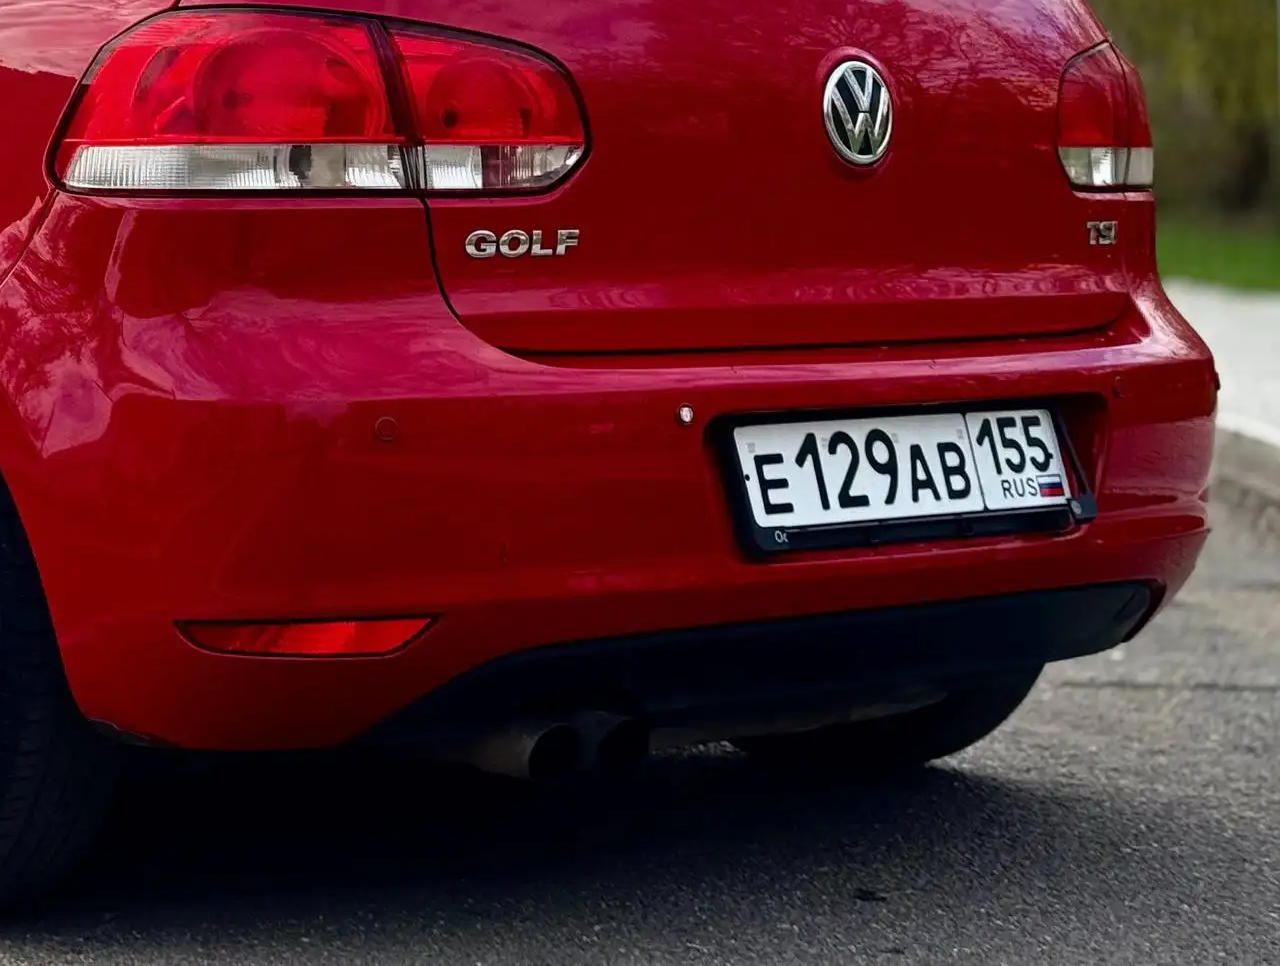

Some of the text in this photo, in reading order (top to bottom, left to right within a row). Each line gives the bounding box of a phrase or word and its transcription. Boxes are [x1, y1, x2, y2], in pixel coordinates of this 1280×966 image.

[465, 229, 580, 258] GOLF
[753, 415, 1051, 516] E129AB 155
[1001, 476, 1038, 499] RUS
